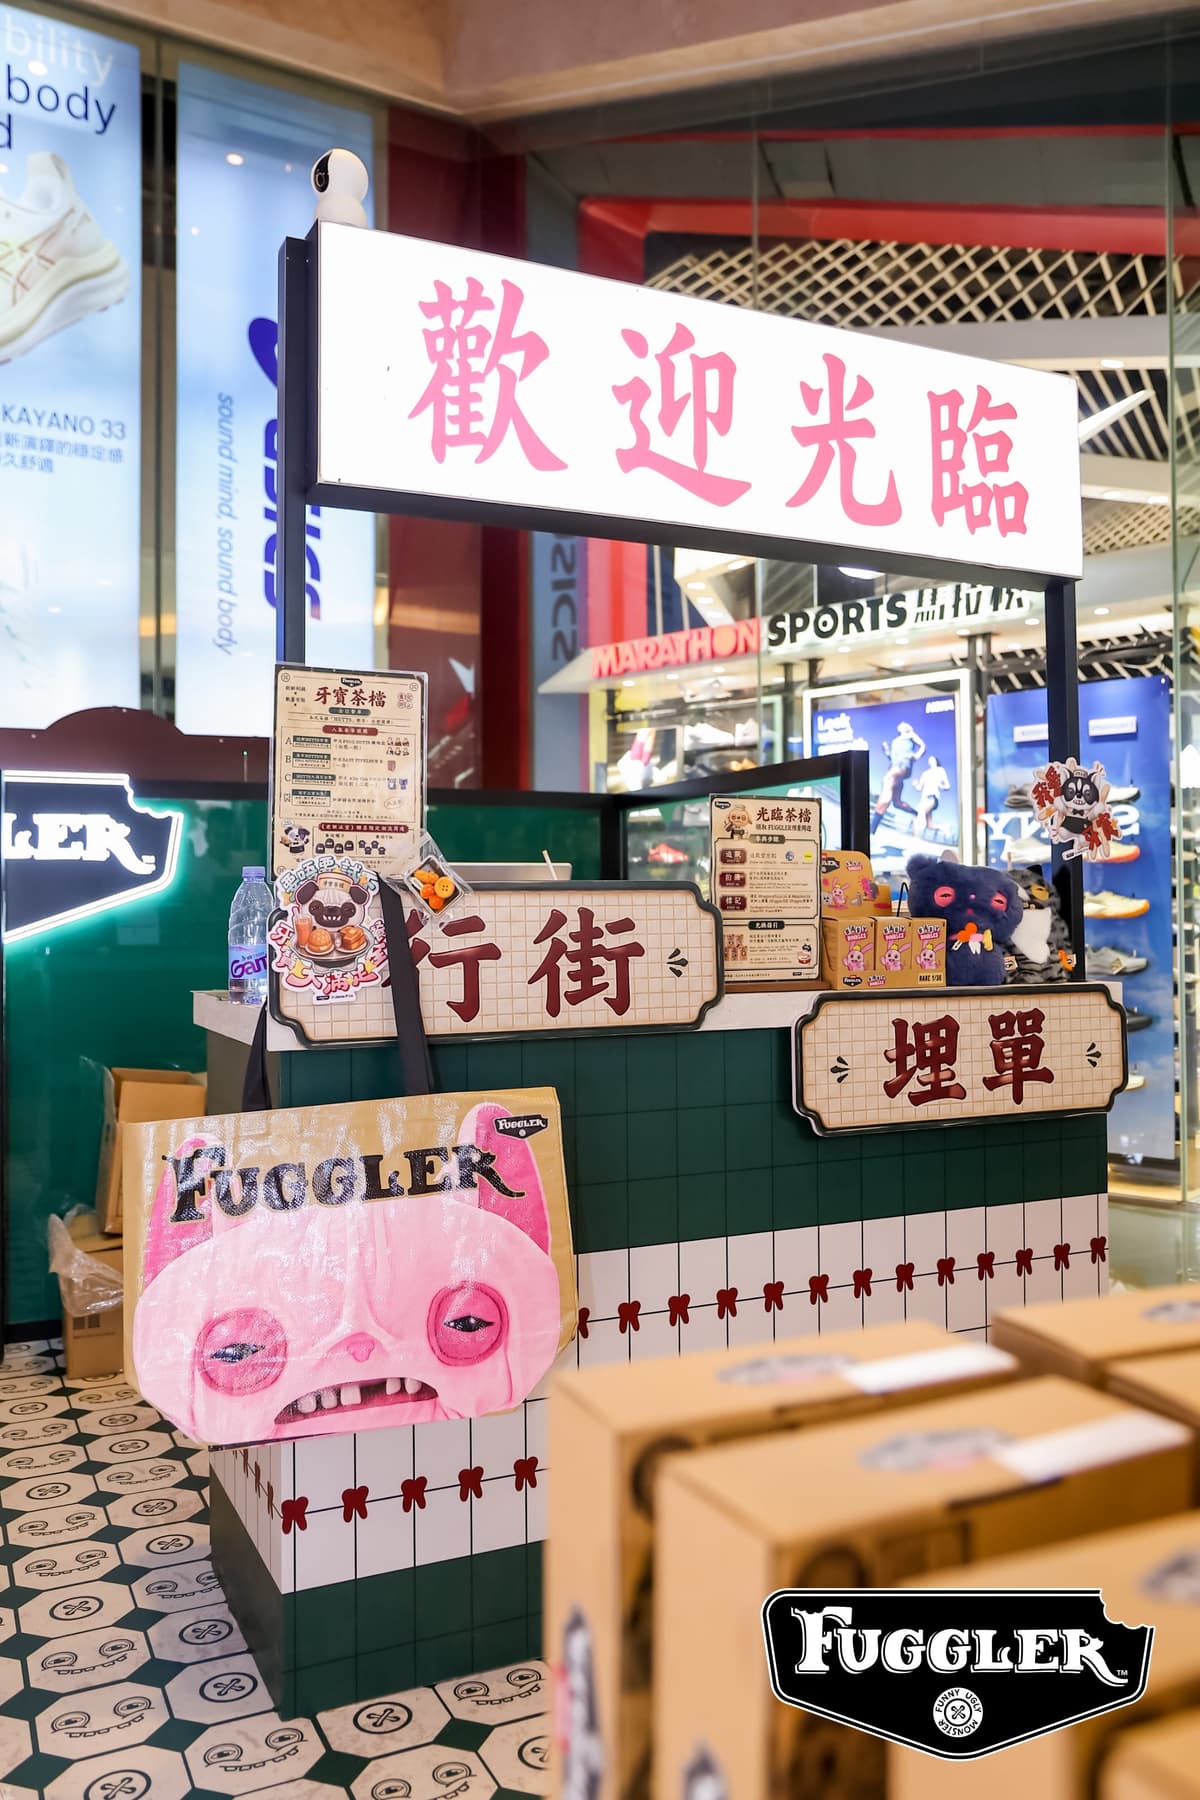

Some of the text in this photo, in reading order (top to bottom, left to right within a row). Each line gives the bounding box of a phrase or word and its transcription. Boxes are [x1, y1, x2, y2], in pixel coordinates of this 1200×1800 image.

[7, 64, 116, 135] body
[2, 403, 126, 440] KAYANO 33
[407, 276, 1029, 537] 歡迎光臨
[212, 392, 238, 656] sound mind, sound body
[591, 617, 761, 679] MARATHON
[768, 593, 907, 646] SPORTS
[314, 686, 387, 707] 牙寶茶檔
[756, 806, 812, 823] 光臨茶檔
[381, 907, 646, 1023] 行街
[883, 1008, 1055, 1107] 埋單
[497, 1115, 547, 1131] FUGGLER
[162, 1144, 526, 1224] FUGGLER
